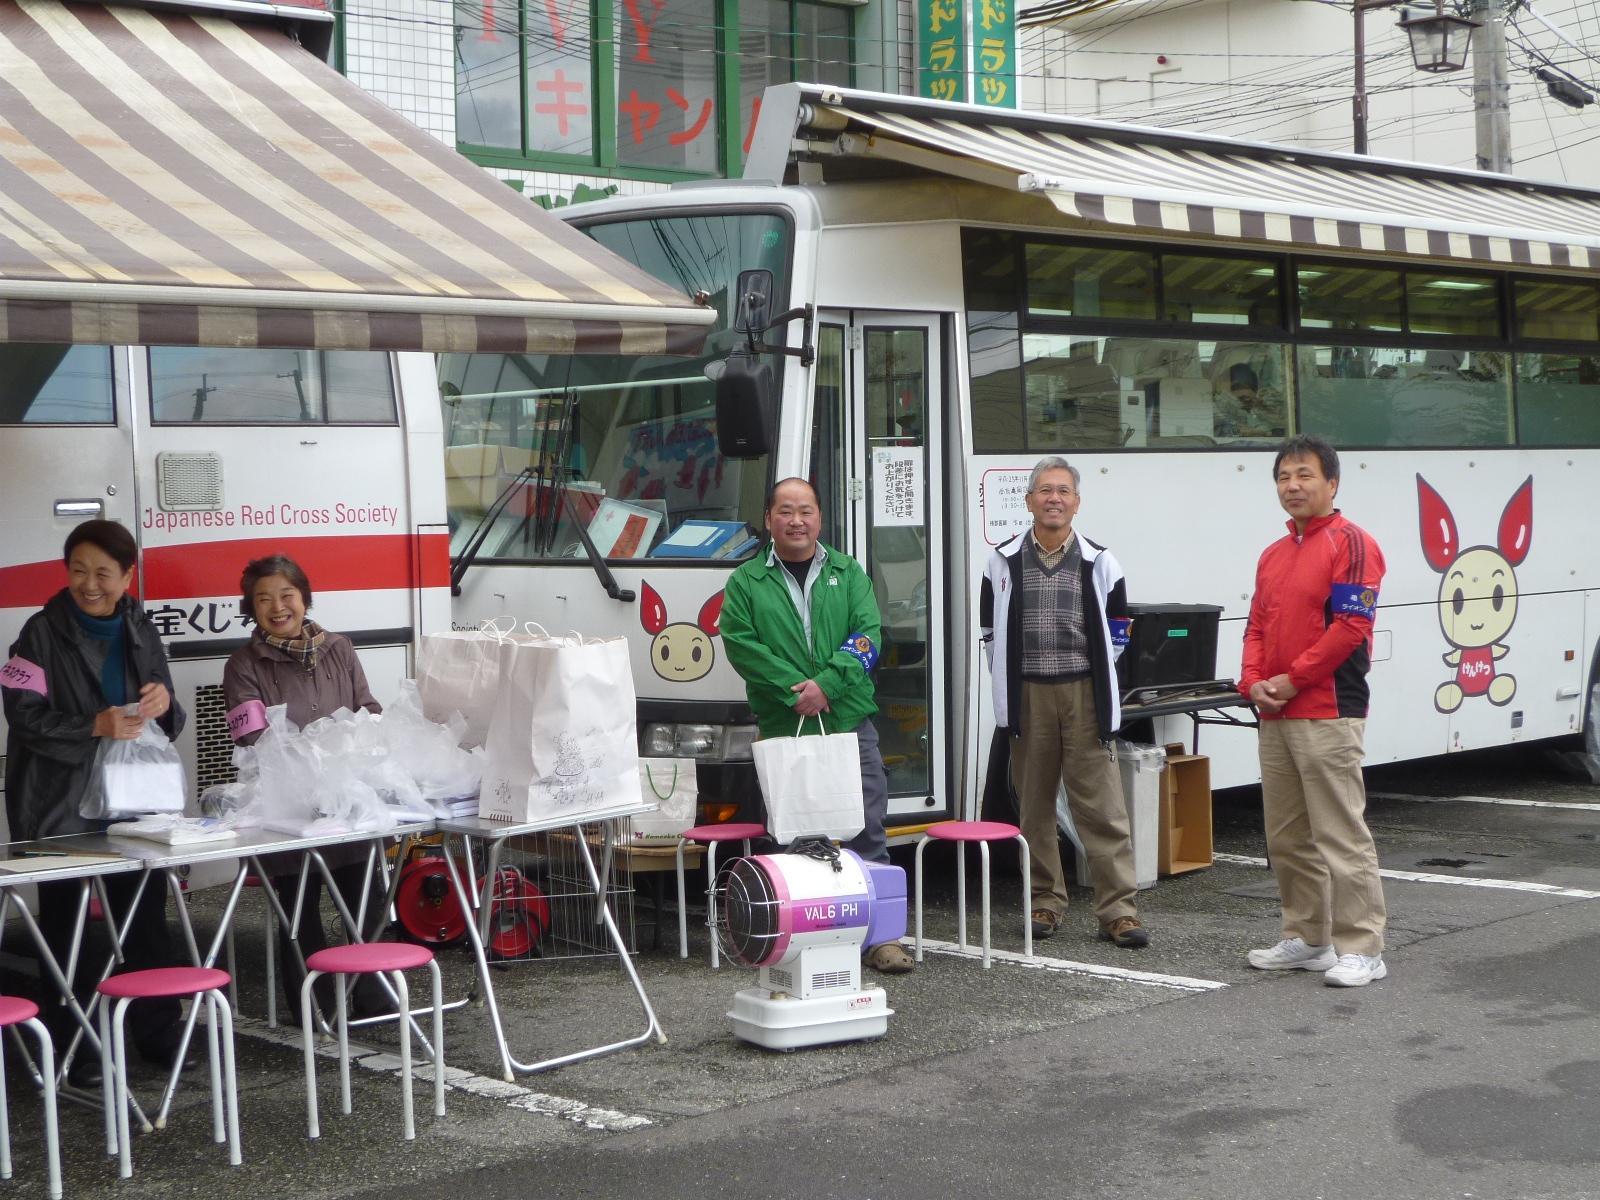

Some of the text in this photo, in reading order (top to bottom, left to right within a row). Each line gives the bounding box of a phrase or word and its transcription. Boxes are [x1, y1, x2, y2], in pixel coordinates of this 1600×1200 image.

[533, 68, 761, 154] キャン
[143, 502, 398, 533] Japanese Red Cross Society
[1462, 660, 1491, 677] けんけつ
[804, 902, 858, 920] VAL6 PH
